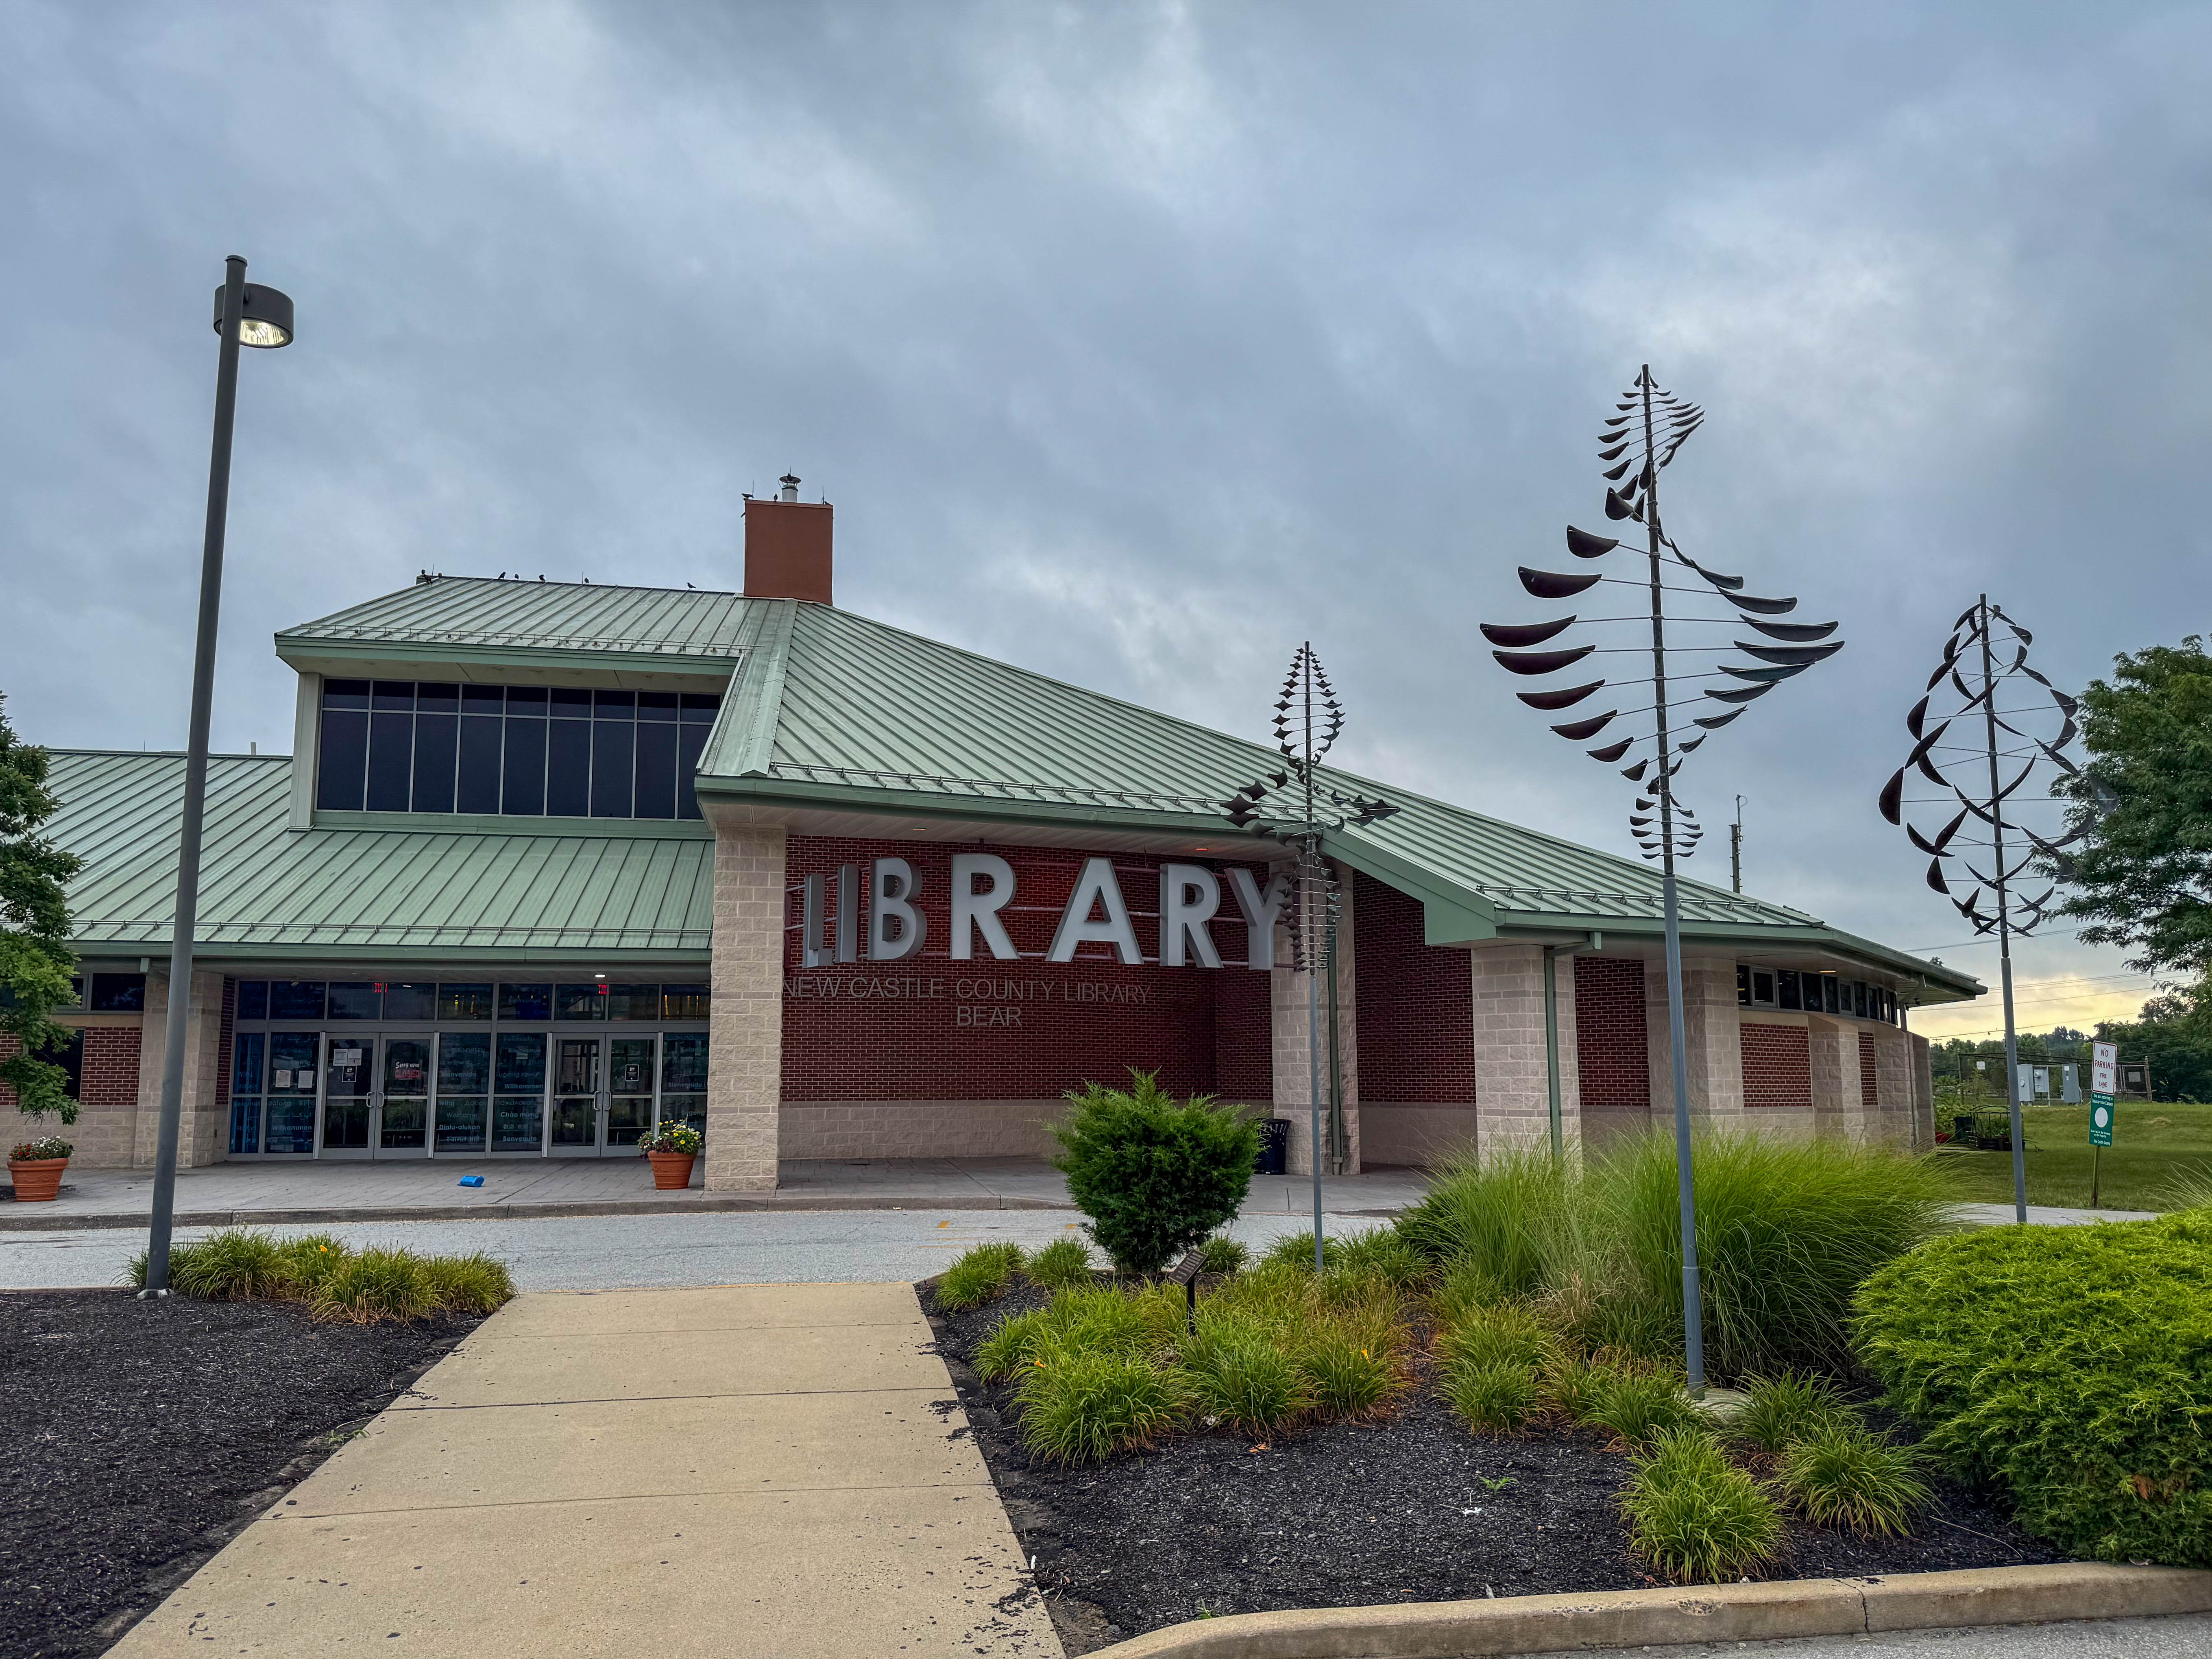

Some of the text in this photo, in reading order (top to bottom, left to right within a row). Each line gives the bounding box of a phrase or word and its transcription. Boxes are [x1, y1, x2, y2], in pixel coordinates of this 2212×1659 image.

[802, 853, 1296, 970] LIBRARY
[783, 976, 1151, 1005] NEW CASTLE COUNTY LIBRARY
[957, 1006, 1023, 1026] BEAR
[2101, 1049, 2108, 1057] NO
[2095, 1059, 2114, 1070] PARKING
